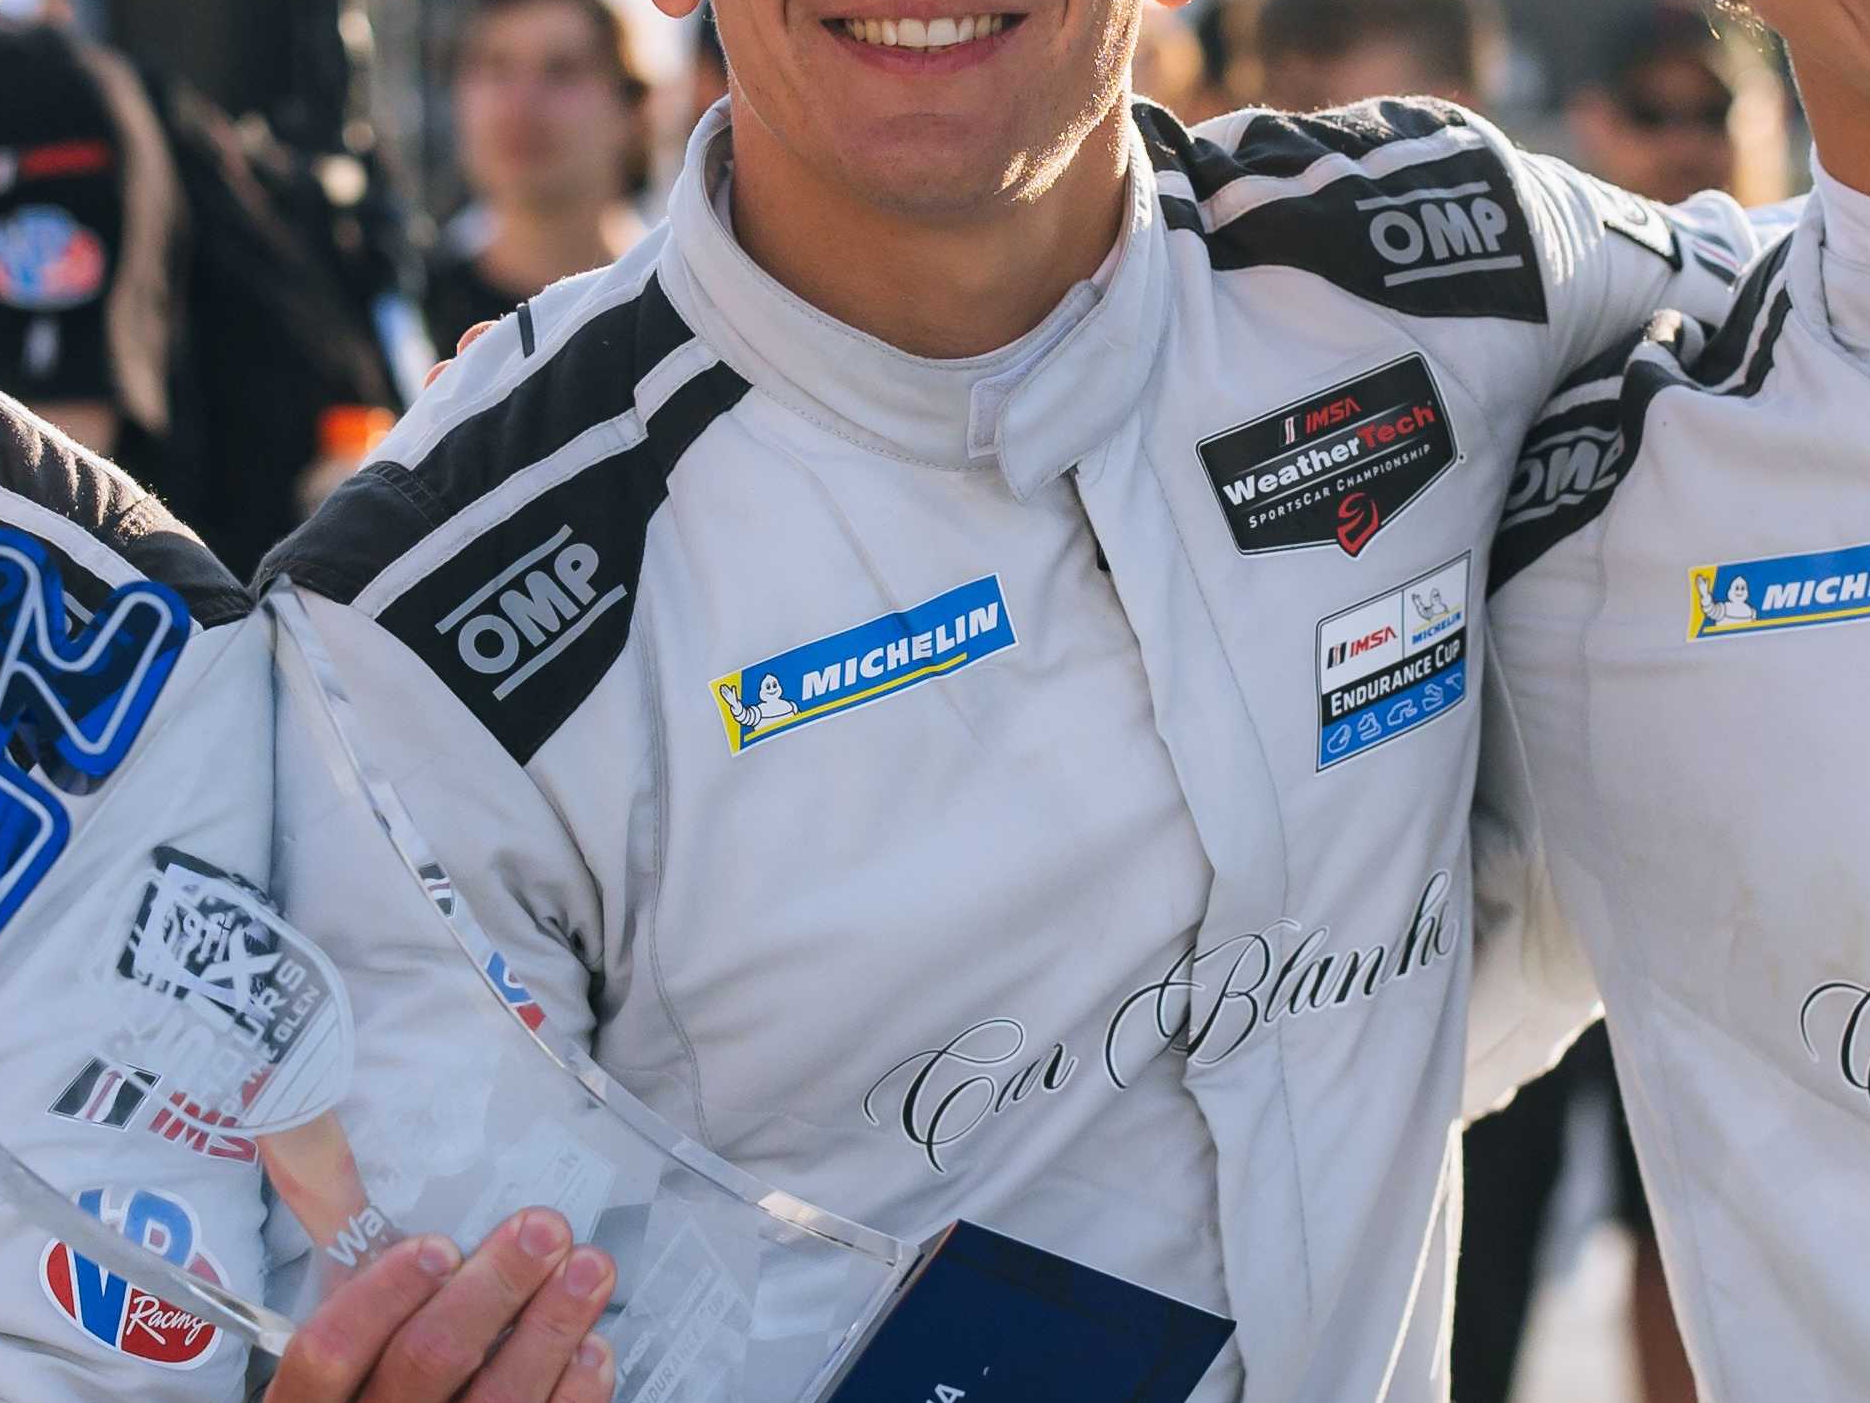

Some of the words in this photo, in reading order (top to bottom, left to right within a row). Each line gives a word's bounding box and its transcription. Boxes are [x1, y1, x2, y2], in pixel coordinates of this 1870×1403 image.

[1369, 198, 1507, 264] OMP
[1305, 397, 1362, 435] IMSA
[1223, 403, 1436, 507] WeatherTech
[1336, 443, 1431, 492] CHAMPIONSHIP
[458, 542, 600, 675] OMP
[1411, 610, 1463, 646] MICHELIN
[801, 600, 1001, 702] MICHELIN
[1349, 626, 1398, 658] IMSA
[1330, 658, 1432, 717] ENDURANCE
[1434, 638, 1462, 671] CUP
[125, 1295, 210, 1347] Racing
